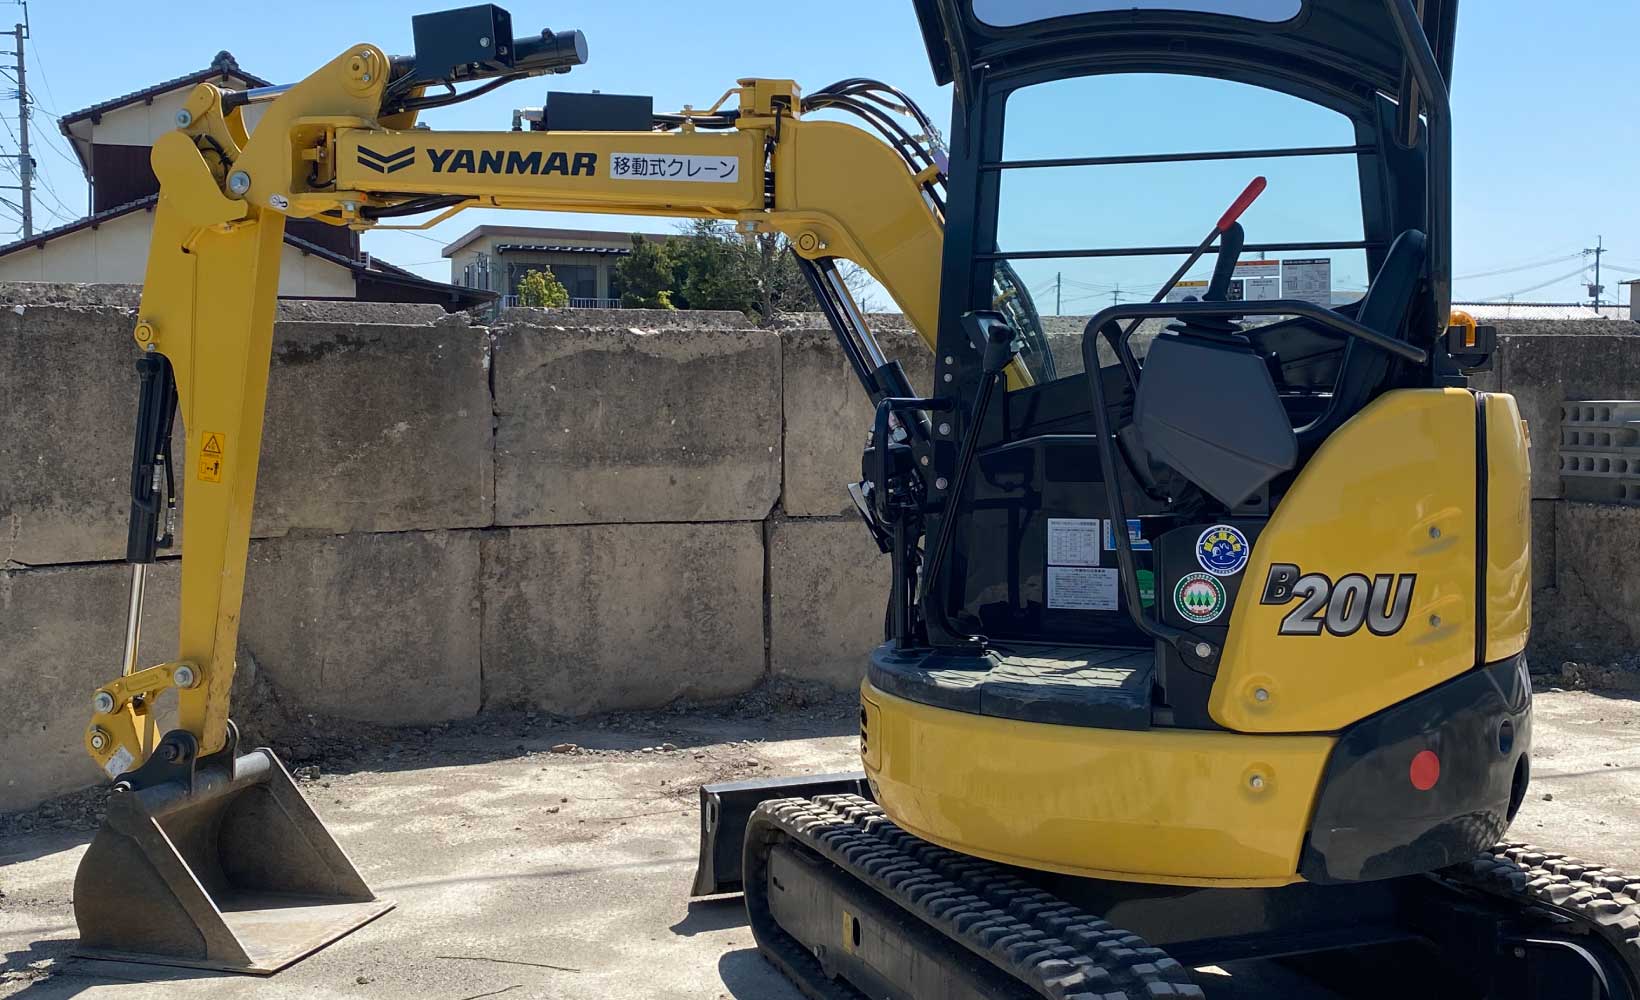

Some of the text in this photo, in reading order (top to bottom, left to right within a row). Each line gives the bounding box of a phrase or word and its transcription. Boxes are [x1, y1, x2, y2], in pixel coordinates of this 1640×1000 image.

[426, 149, 597, 176] YANMAR
[614, 156, 735, 178] 移動式クレーン
